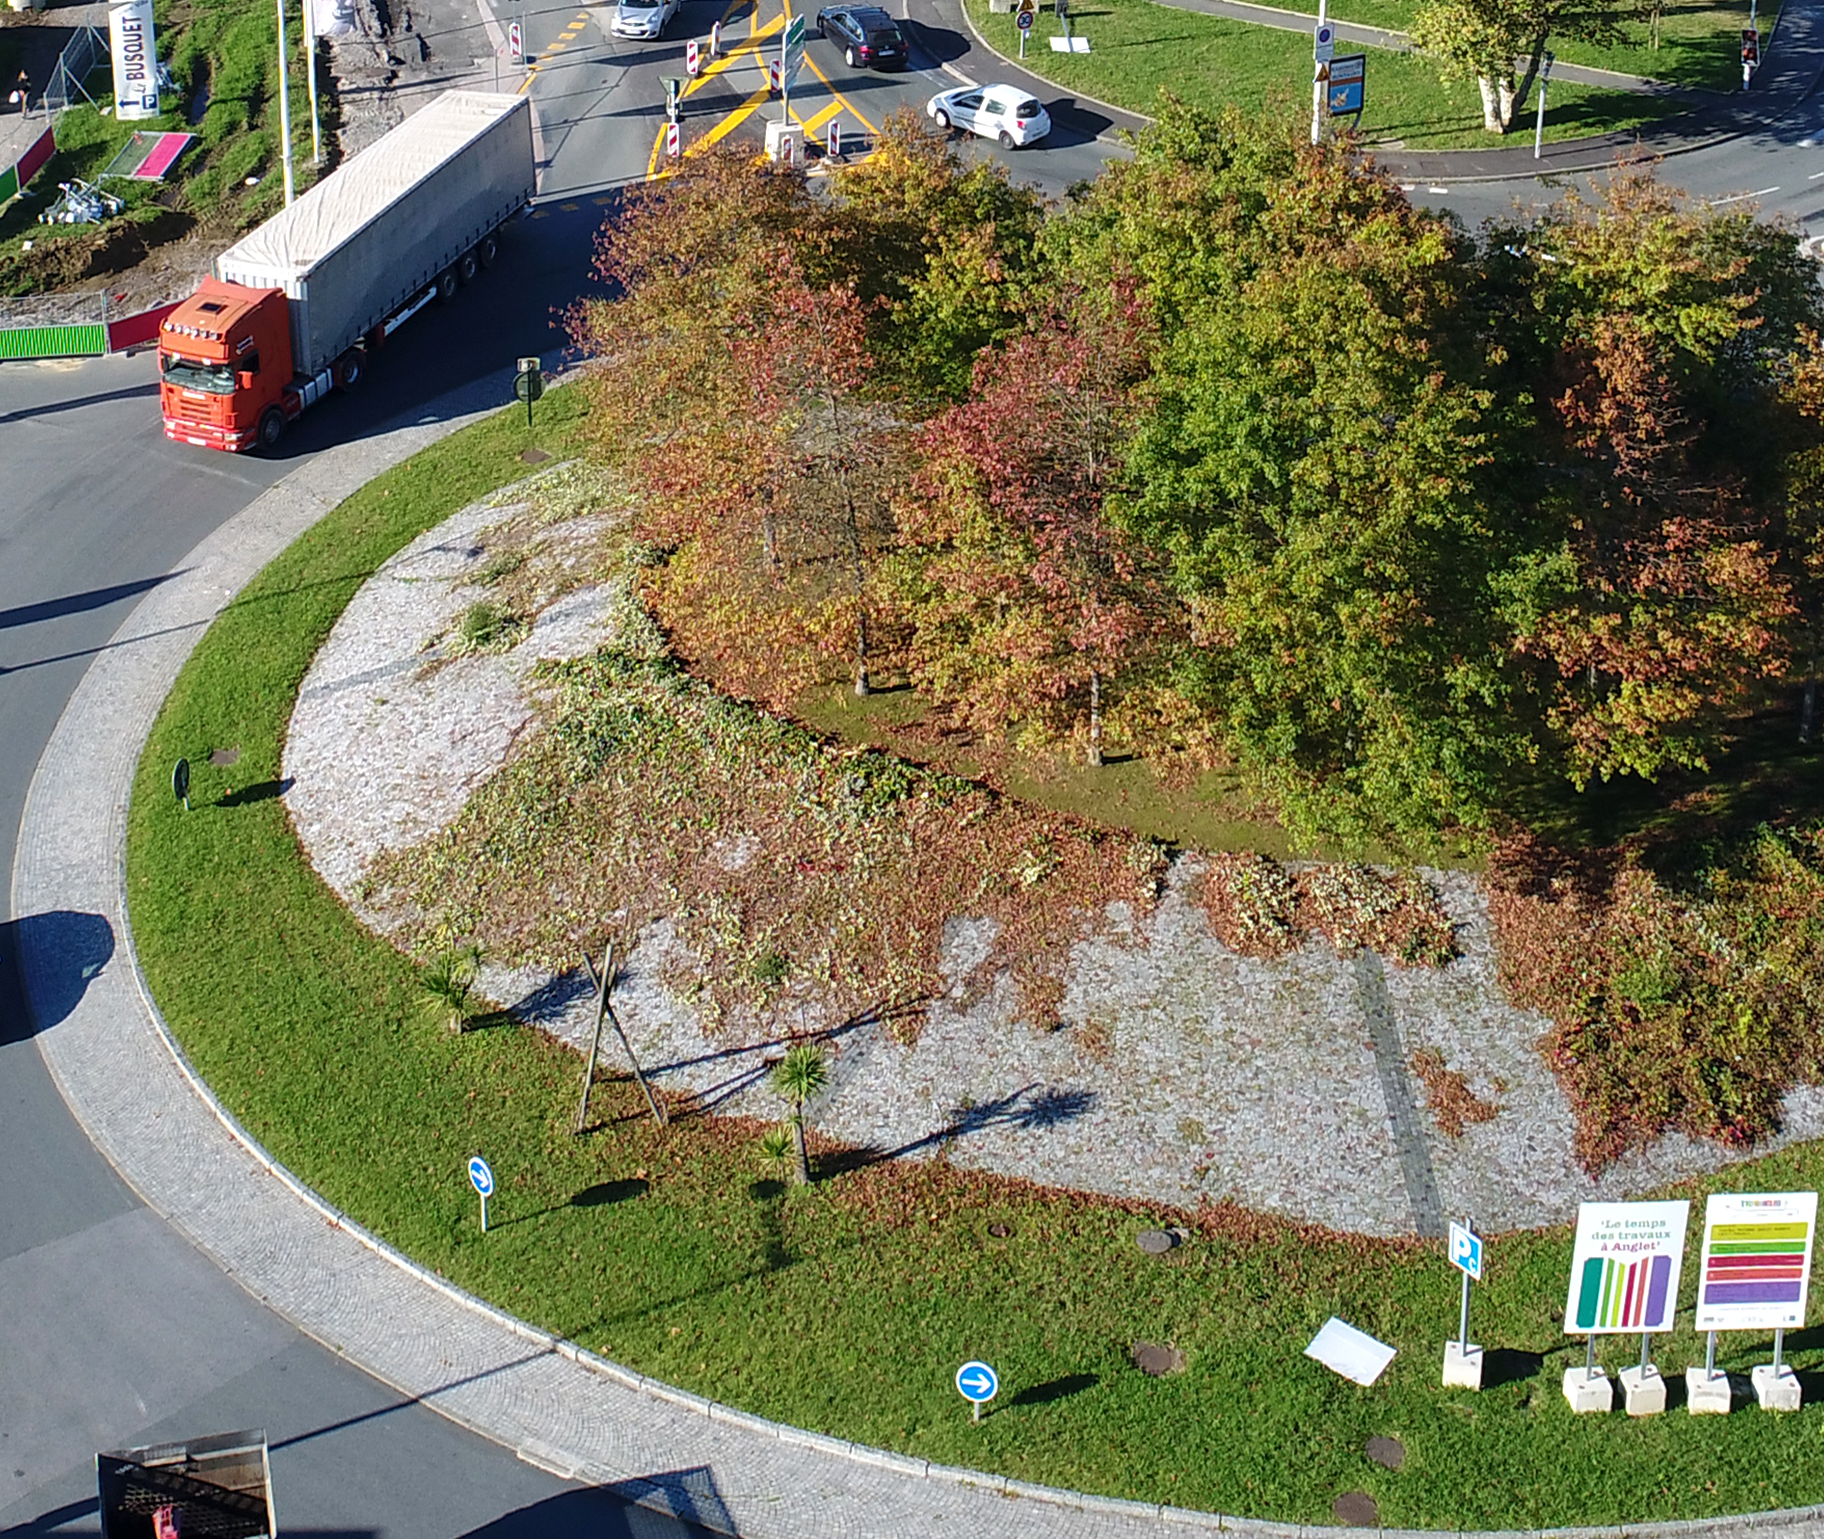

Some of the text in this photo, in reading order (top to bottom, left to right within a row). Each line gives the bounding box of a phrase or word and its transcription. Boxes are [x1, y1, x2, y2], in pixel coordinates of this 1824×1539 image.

[1020, 15, 1031, 25] 30
[122, 16, 144, 81] BUSQUET
[1625, 1219, 1667, 1230] temps
[1591, 1230, 1671, 1240] des travaux
